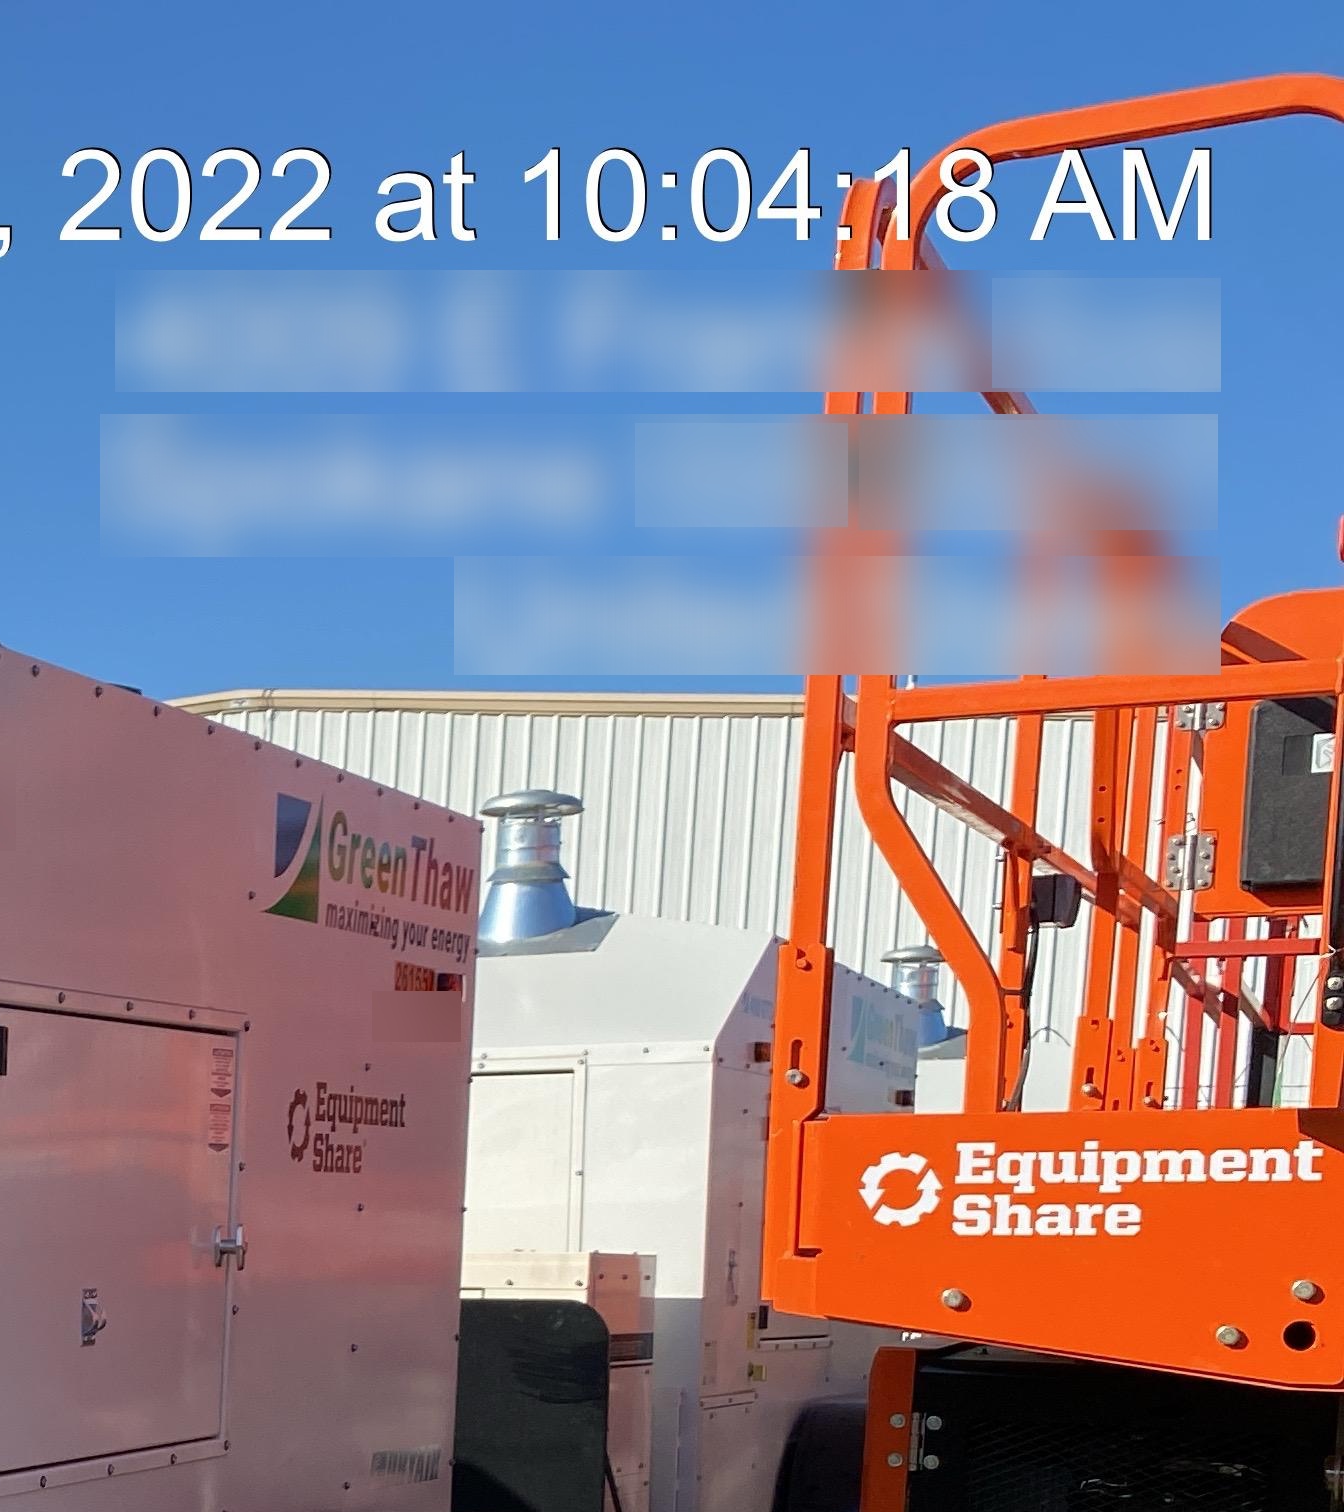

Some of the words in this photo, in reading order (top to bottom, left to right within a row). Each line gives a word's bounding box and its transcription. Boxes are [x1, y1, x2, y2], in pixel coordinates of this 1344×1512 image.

[324, 900, 400, 950] maximizing
[400, 919, 430, 952] your
[430, 927, 472, 963] energy
[314, 1081, 406, 1134] Equipment
[312, 1132, 362, 1173] Share
[954, 1139, 1324, 1195] Equipment
[951, 1193, 1143, 1237] Share
